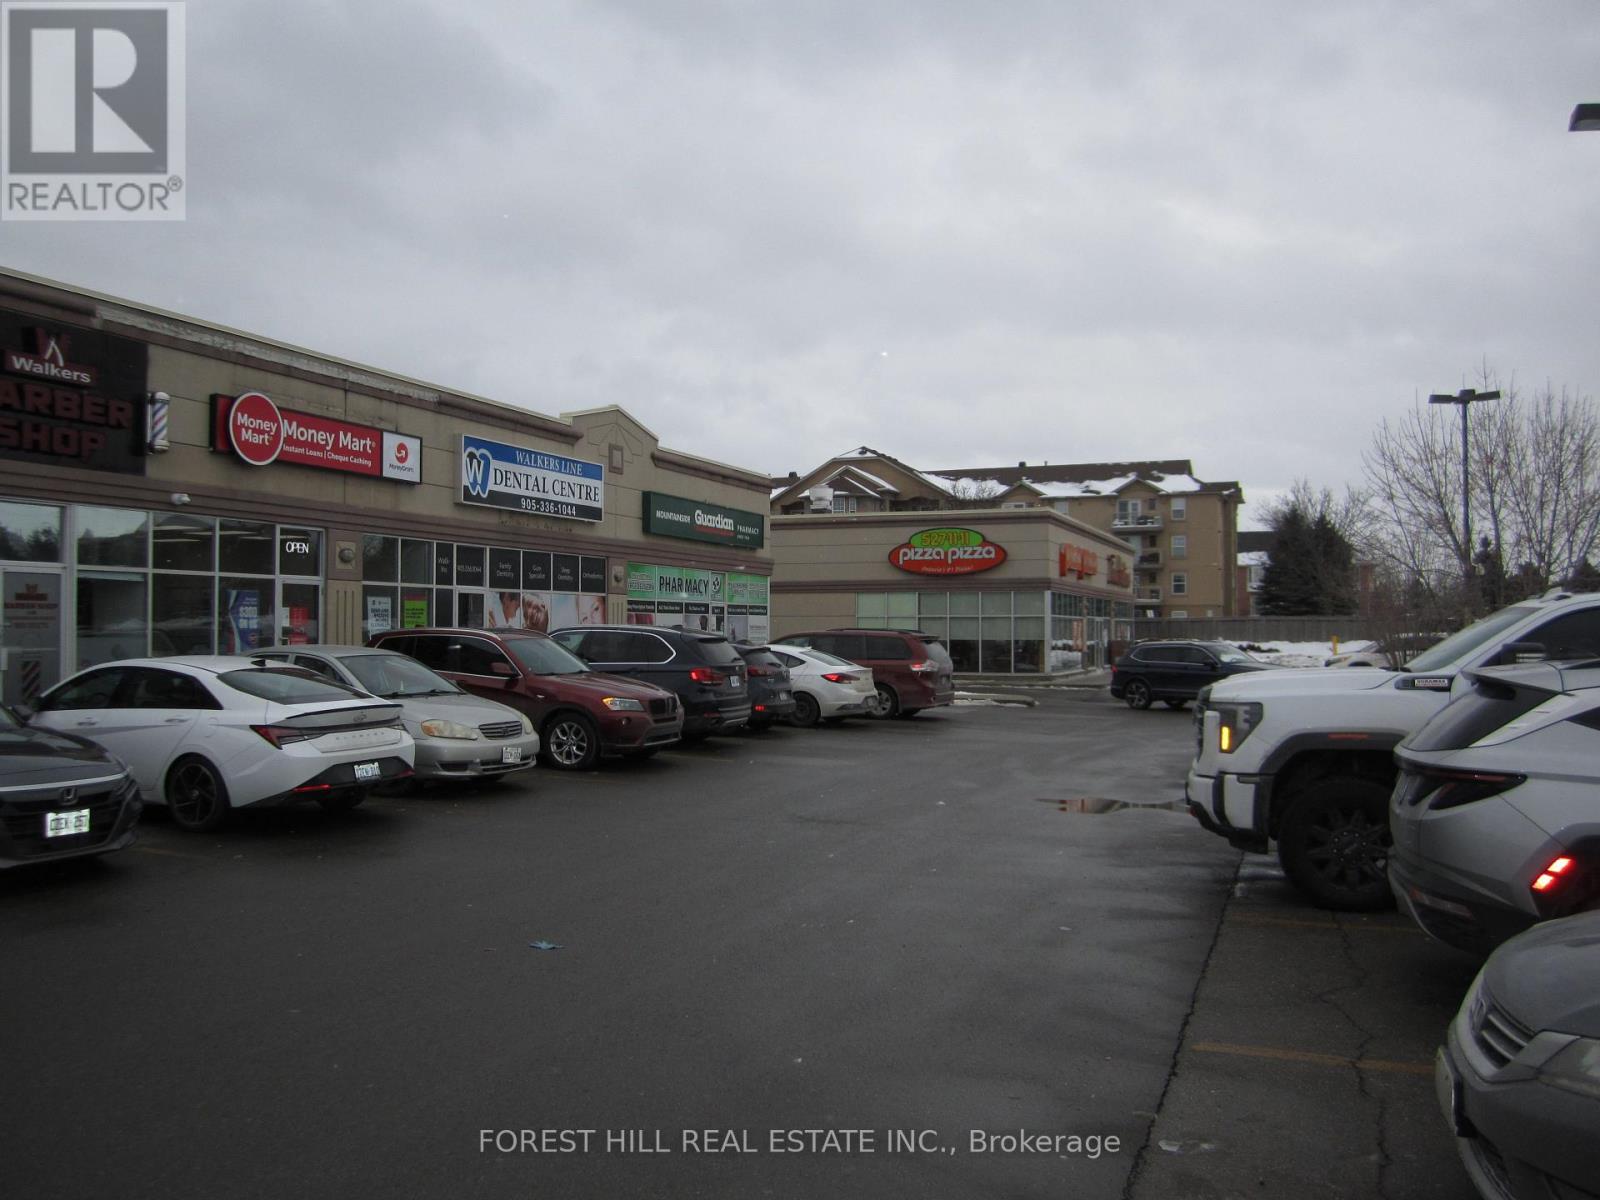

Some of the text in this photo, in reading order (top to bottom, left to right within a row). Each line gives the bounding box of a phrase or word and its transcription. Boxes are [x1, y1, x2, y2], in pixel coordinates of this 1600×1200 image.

[11, 355, 92, 383] Walkers
[237, 412, 278, 435] Money
[283, 419, 335, 450] Money
[0, 415, 106, 463] SHOP
[283, 445, 372, 467] Instant Loans Cheque Cashing
[516, 450, 583, 476] WALKERS LINE
[493, 467, 600, 502] DENTAL CENTRE
[520, 497, 577, 517] 905-336-1044
[694, 509, 734, 531] Guardian
[737, 524, 759, 535] PHARMACY
[285, 541, 309, 554] OPEN
[899, 545, 996, 565] pizza pizza
[659, 575, 709, 595] PHARMACY
